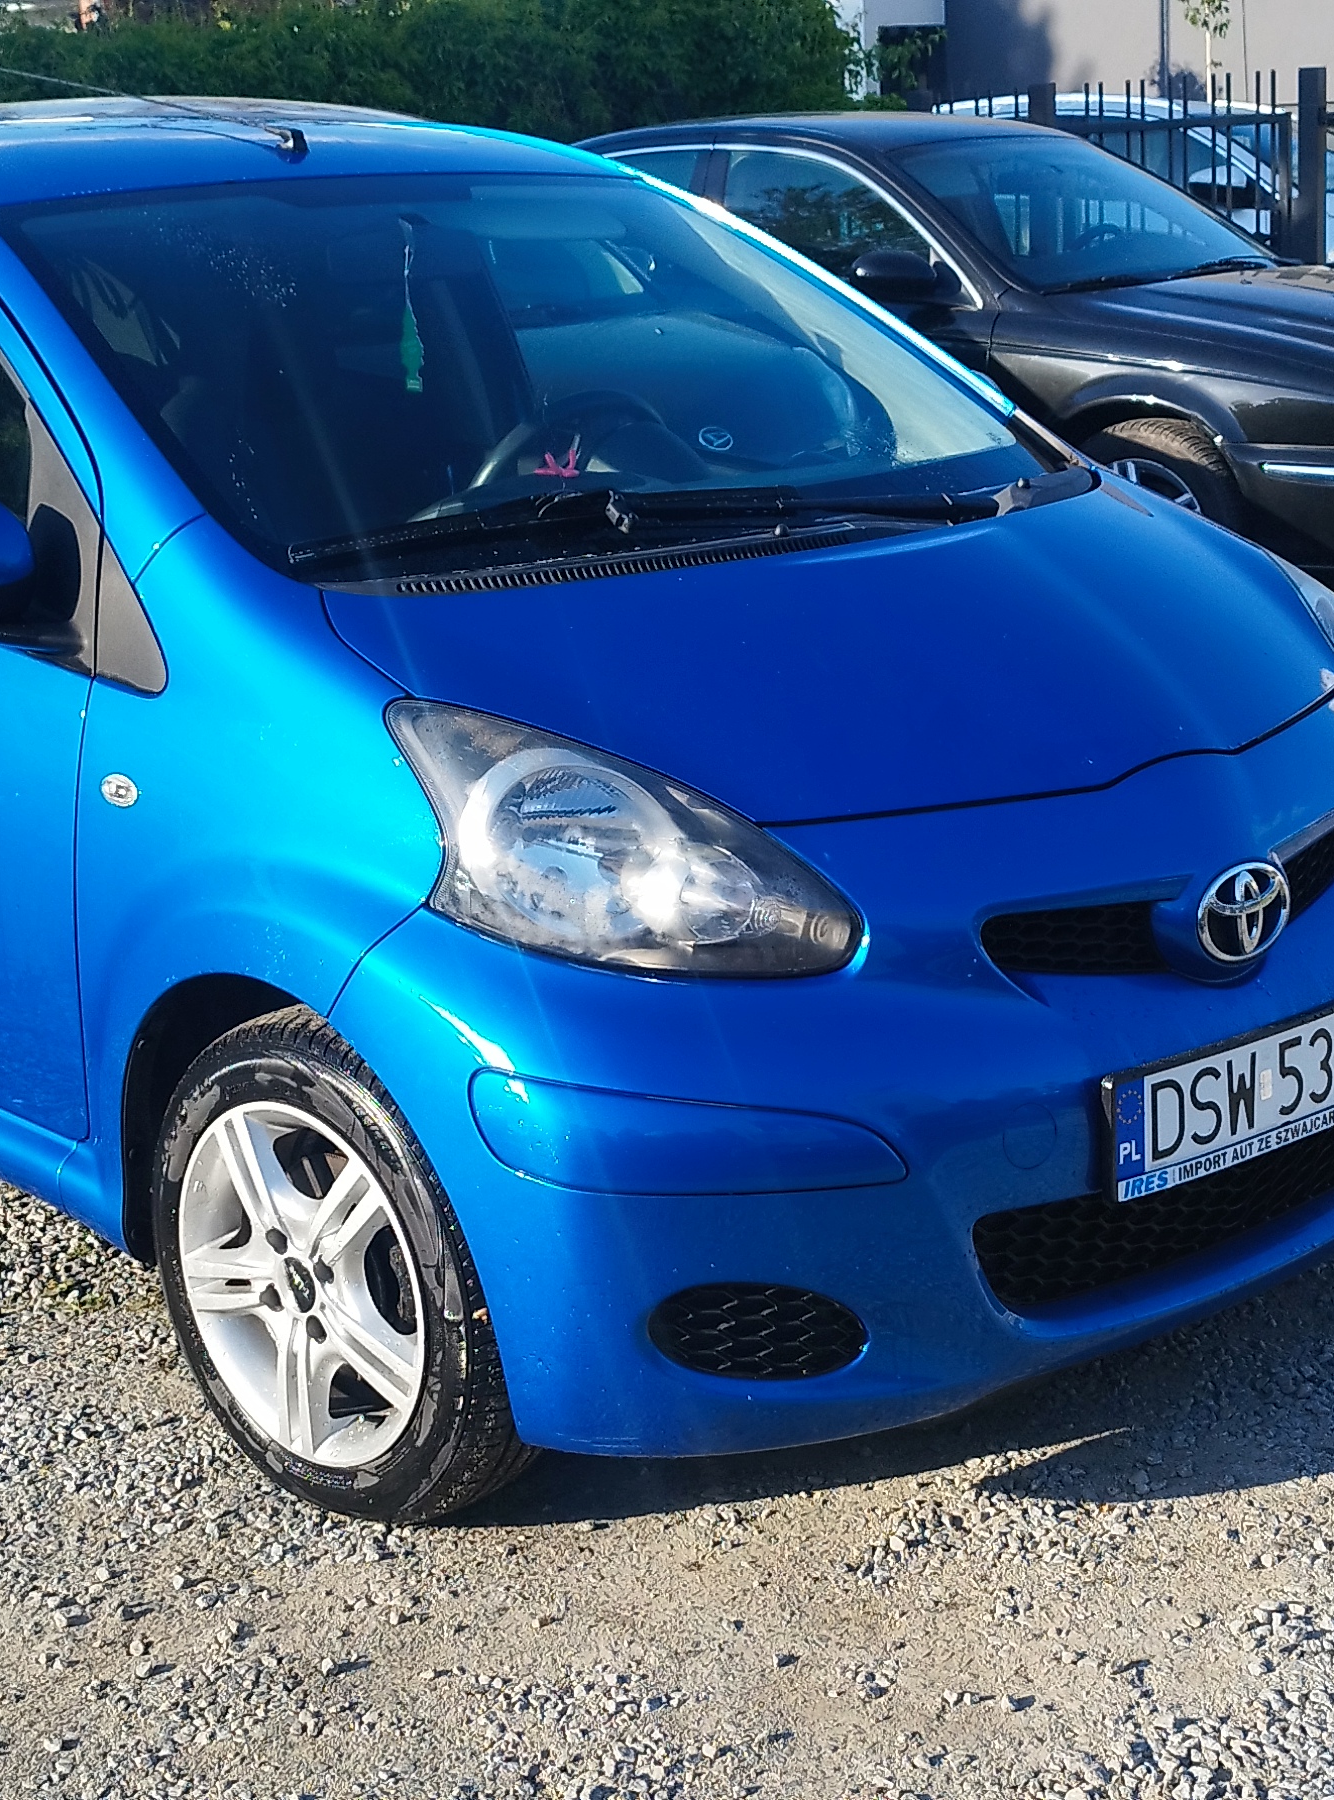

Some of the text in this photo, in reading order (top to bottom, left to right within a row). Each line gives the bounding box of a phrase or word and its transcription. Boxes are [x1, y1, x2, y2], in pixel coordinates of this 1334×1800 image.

[1151, 1051, 1257, 1162] DSW
[1119, 1139, 1141, 1165] PL
[1123, 1170, 1168, 1199] IRES
[1178, 1151, 1228, 1182] IMPORT
[1231, 1141, 1254, 1163] AUT
[1257, 1135, 1272, 1153] ZE
